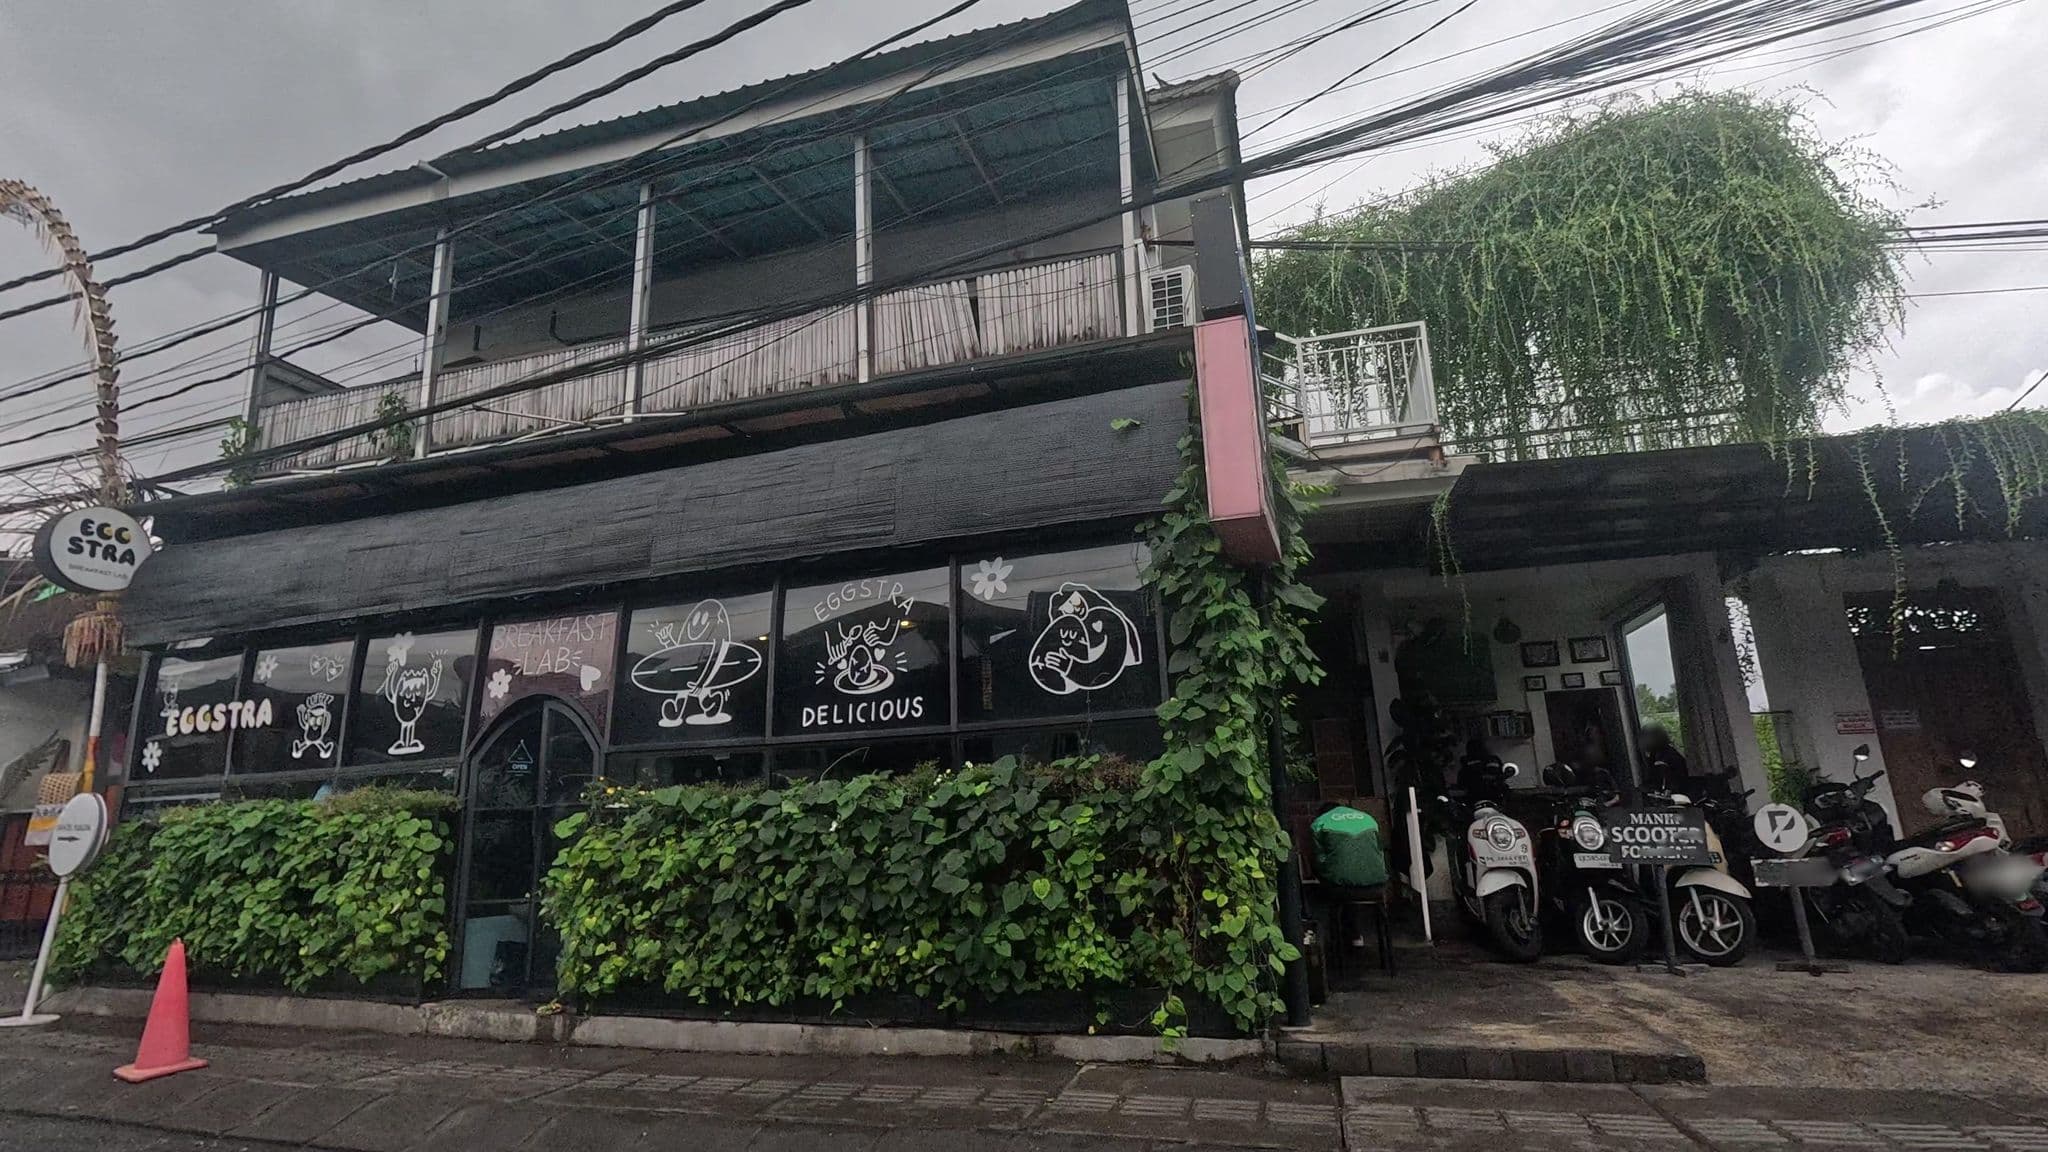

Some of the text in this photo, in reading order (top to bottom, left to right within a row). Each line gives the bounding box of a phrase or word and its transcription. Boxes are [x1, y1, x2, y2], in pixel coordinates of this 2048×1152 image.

[80, 518, 131, 544] EGG
[67, 536, 135, 566] STRA
[814, 579, 914, 621] EGGSTRA
[493, 612, 616, 652] BREAKFAST
[523, 646, 570, 675] LAB
[166, 698, 272, 737] EGGSTRA
[802, 696, 923, 727] DELICIOUS
